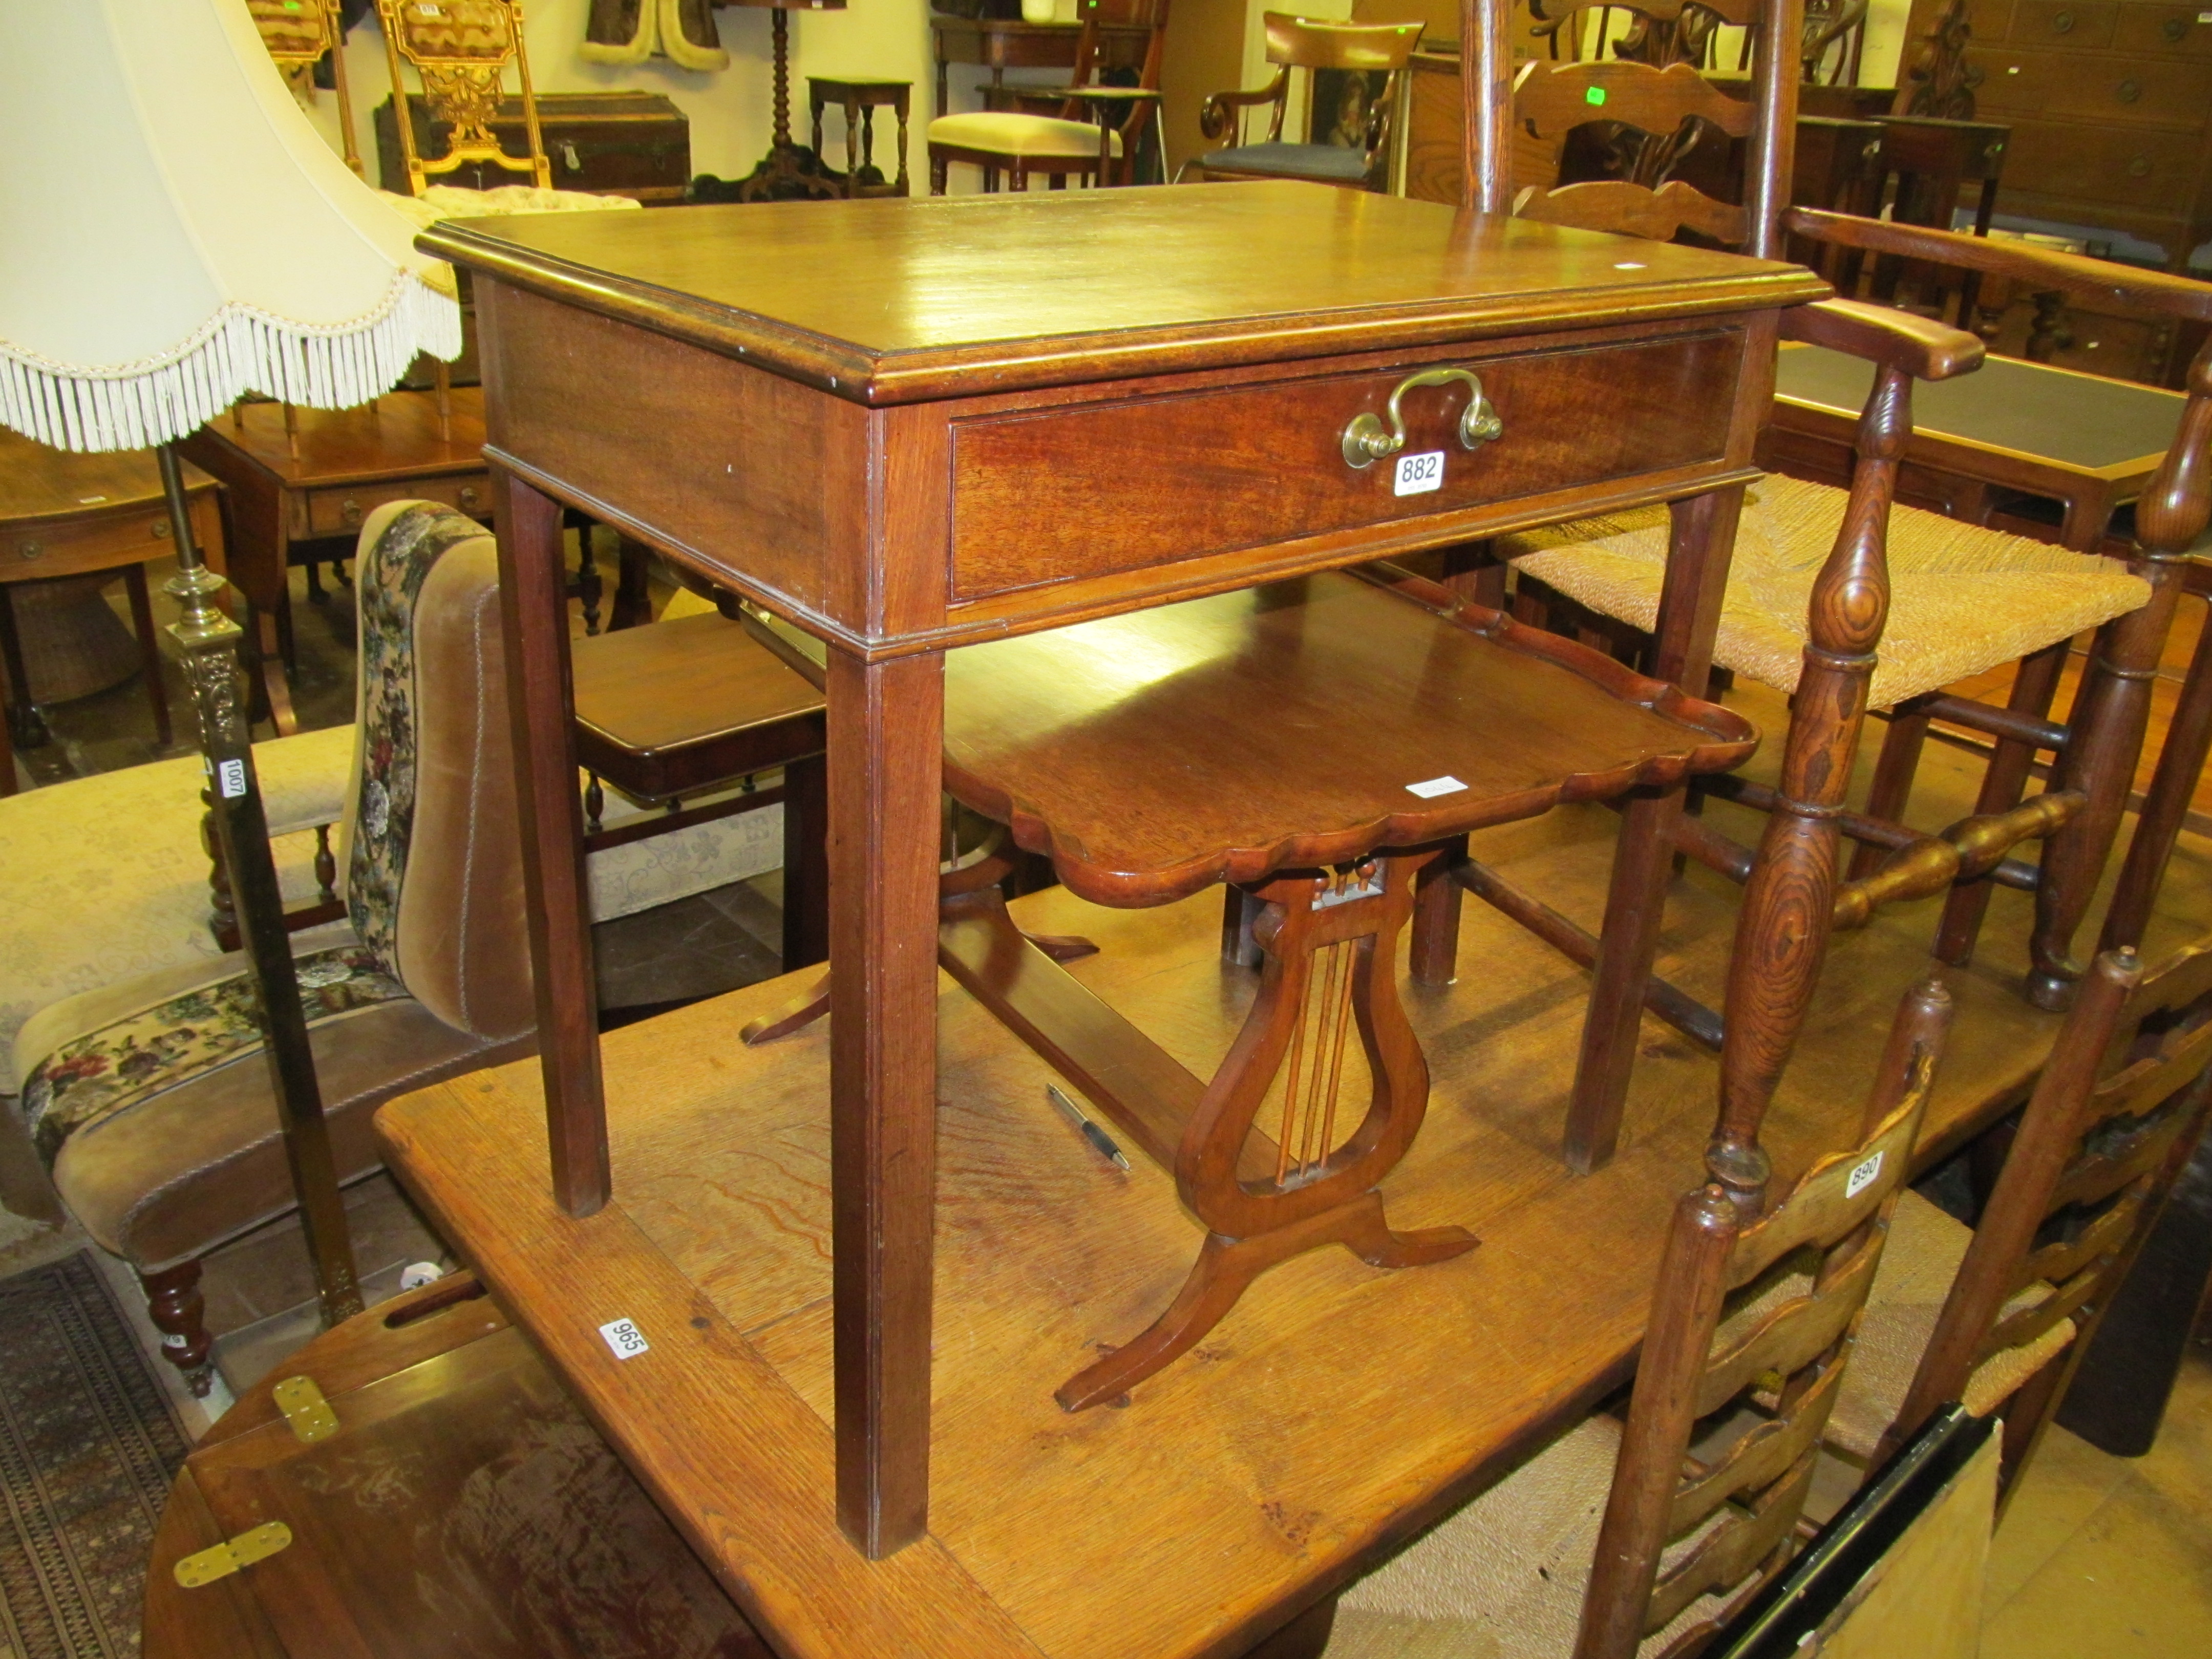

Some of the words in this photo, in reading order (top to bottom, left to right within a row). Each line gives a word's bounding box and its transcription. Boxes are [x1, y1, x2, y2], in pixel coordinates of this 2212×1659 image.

[1402, 456, 1436, 482] 882
[227, 761, 243, 792] 1007
[1419, 783, 1455, 793] 1044
[1852, 1155, 1878, 1185] 890
[613, 1323, 645, 1350] 965
